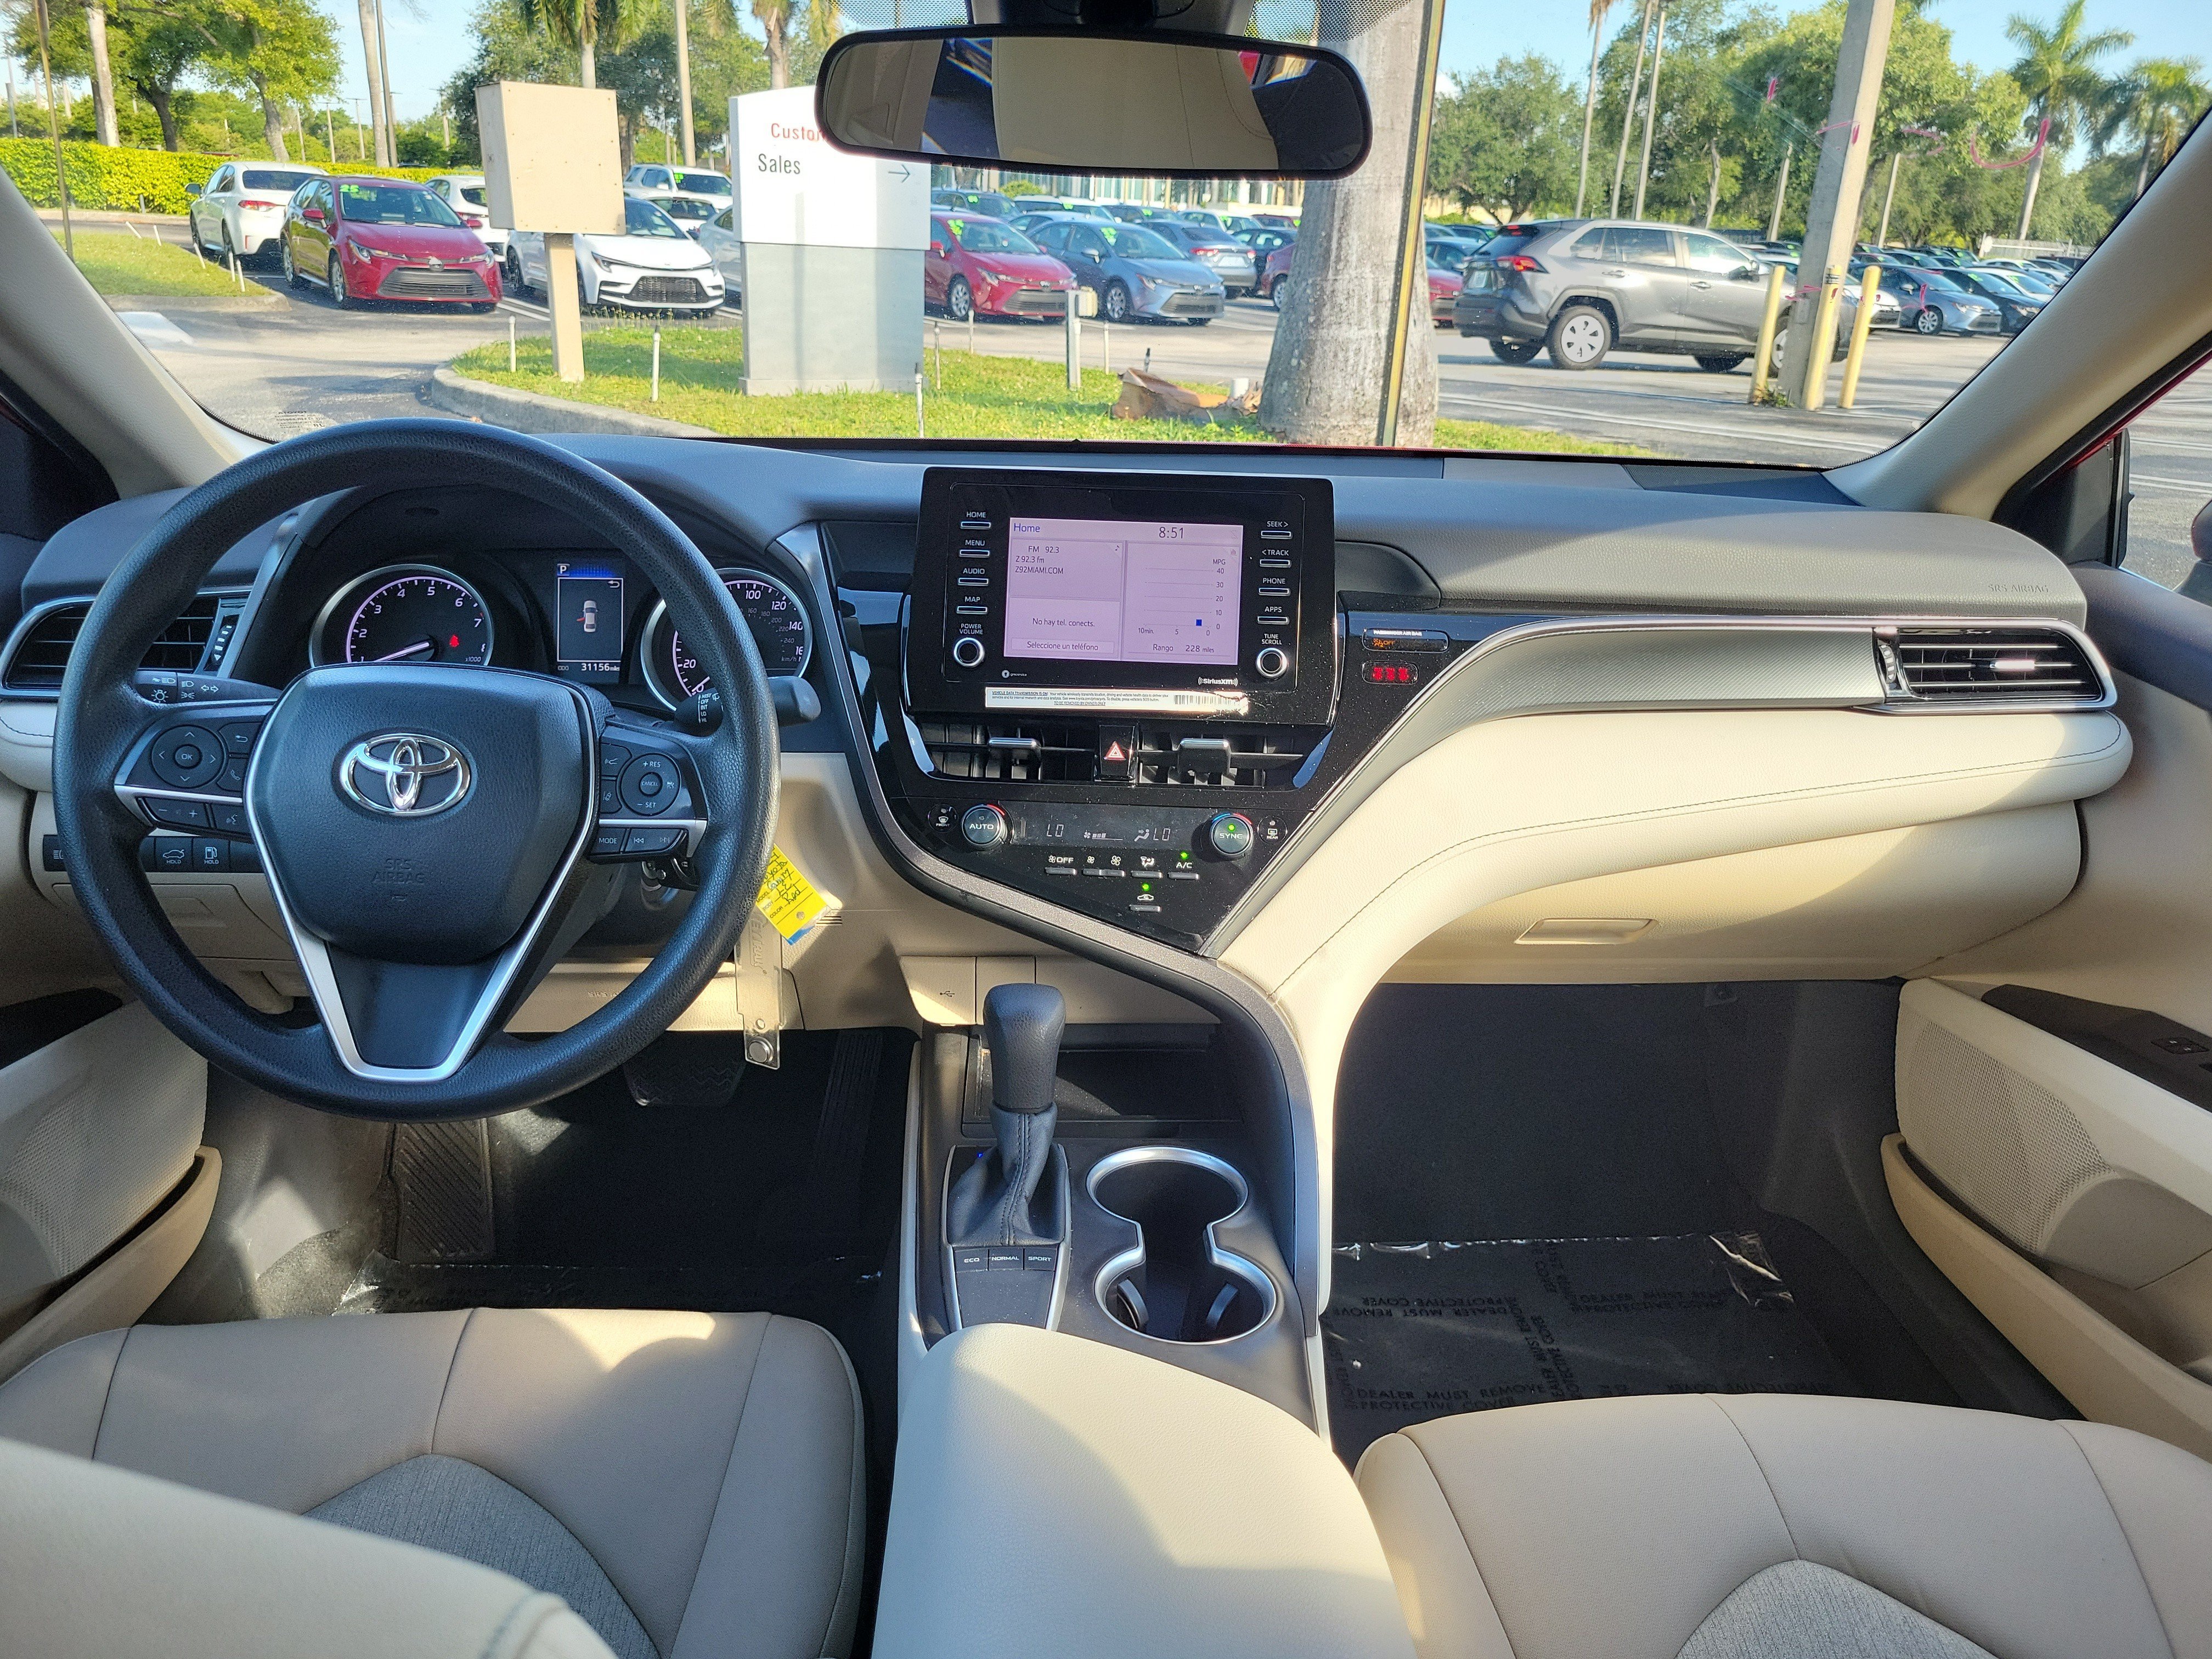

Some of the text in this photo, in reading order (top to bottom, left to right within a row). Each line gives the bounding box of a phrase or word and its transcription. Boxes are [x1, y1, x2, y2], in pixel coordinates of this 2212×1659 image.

[771, 123, 823, 142] Custo
[758, 154, 800, 174] Sales
[1014, 523, 1040, 532] Home
[1159, 527, 1184, 539] 8:51
[560, 565, 567, 574] P
[397, 589, 405, 597] 4
[427, 587, 435, 595] 5
[1988, 584, 2049, 593] SRS AIRBAG
[746, 590, 761, 599] 100
[455, 598, 462, 607] 6
[771, 601, 786, 610] 120
[374, 605, 381, 614] 3
[474, 619, 482, 628] 7
[789, 622, 803, 630] 140
[359, 629, 367, 637] 2
[1153, 644, 1173, 652] Rango
[581, 663, 610, 672] 31156
[683, 659, 696, 668] 20
[1047, 824, 1064, 837] LO
[1153, 827, 1171, 841] LO
[385, 857, 412, 871] SRS
[770, 906, 783, 918] COLOR
[1362, 1297, 1503, 1307] PROTECTIVE COVER
[1402, 1308, 1442, 1317] MUST
[1453, 1306, 1507, 1317] DEALER
[1357, 1384, 1545, 1400] DEALER MUST REMOVE
[1361, 1401, 1454, 1410] PROTECTIVE
